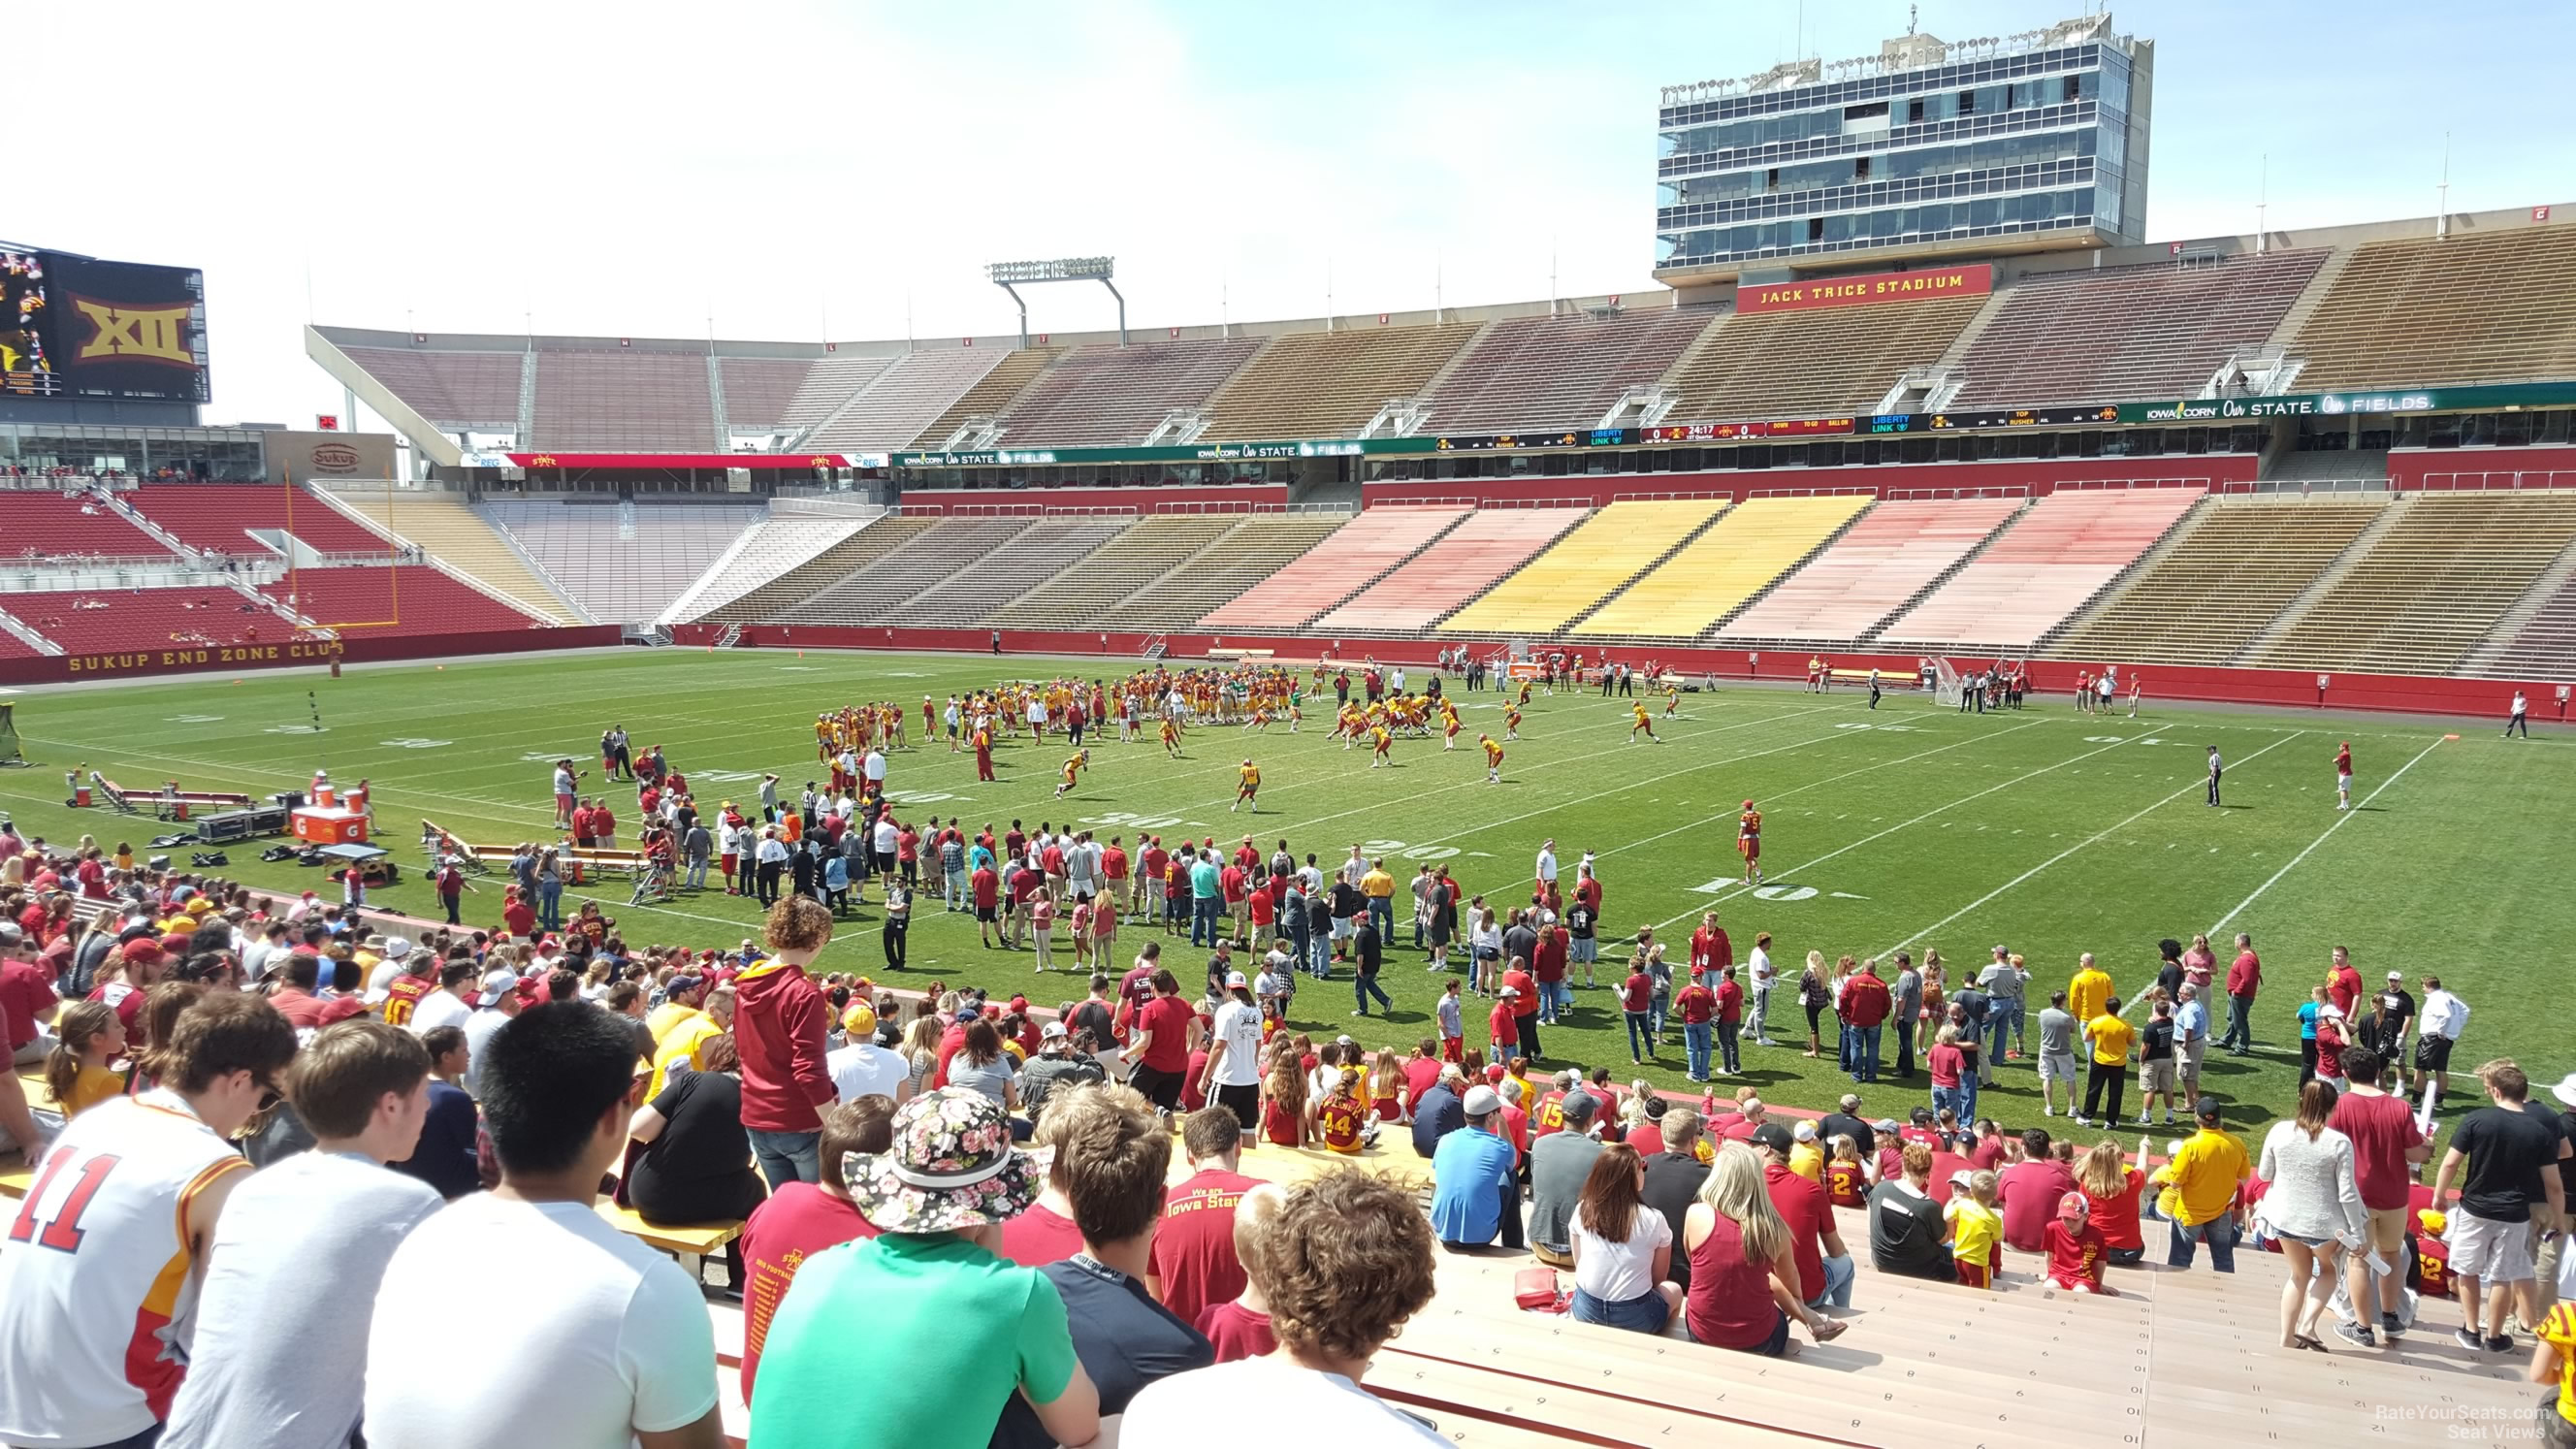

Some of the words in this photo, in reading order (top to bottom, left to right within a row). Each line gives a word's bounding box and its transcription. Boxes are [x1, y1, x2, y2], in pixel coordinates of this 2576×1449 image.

[1760, 290, 1802, 304] JACK
[1813, 284, 1866, 299] TRICE
[1877, 275, 1962, 293] STADIUM
[77, 300, 193, 364] XII
[2147, 409, 2176, 419] IOWA
[2183, 408, 2215, 418] CORN
[2223, 401, 2244, 417] Our
[2251, 402, 2318, 415] STATE.
[2322, 396, 2344, 413] Our
[2353, 398, 2434, 411] FIELDS.
[320, 418, 336, 429] 25
[1873, 415, 1909, 424] LIBERTY
[1654, 430, 1659, 438] 0
[1689, 426, 1714, 435] 24:17
[1741, 426, 1748, 435] 0
[1873, 424, 1893, 433] LINK
[315, 451, 356, 465] Sukup
[1259, 447, 1298, 456] STATE.
[1318, 445, 1364, 455] FIELDS.
[532, 457, 556, 466] STATE
[961, 455, 998, 464] STATE.
[1014, 454, 1057, 463] FIELDS.
[69, 655, 149, 671] SUKUP
[163, 650, 208, 665] END
[221, 647, 279, 661] ZONE
[1246, 769, 1255, 778] 10
[297, 819, 306, 834] G
[1078, 812, 1183, 828] 30
[346, 824, 358, 837] G
[1340, 839, 1462, 860] 20
[1684, 877, 1819, 902] 10
[1542, 1103, 1563, 1127] 15
[1323, 1111, 1351, 1137] 44
[1191, 1187, 1206, 1197] We
[1833, 1174, 1851, 1196] 2
[9, 1144, 122, 1255] 11
[1167, 1199, 1203, 1218] Iowa
[1208, 1195, 1240, 1210] Stat
[768, 1265, 792, 1281] FOOTBAL
[2420, 1254, 2442, 1281] 52
[1455, 1432, 1465, 1441] 6
